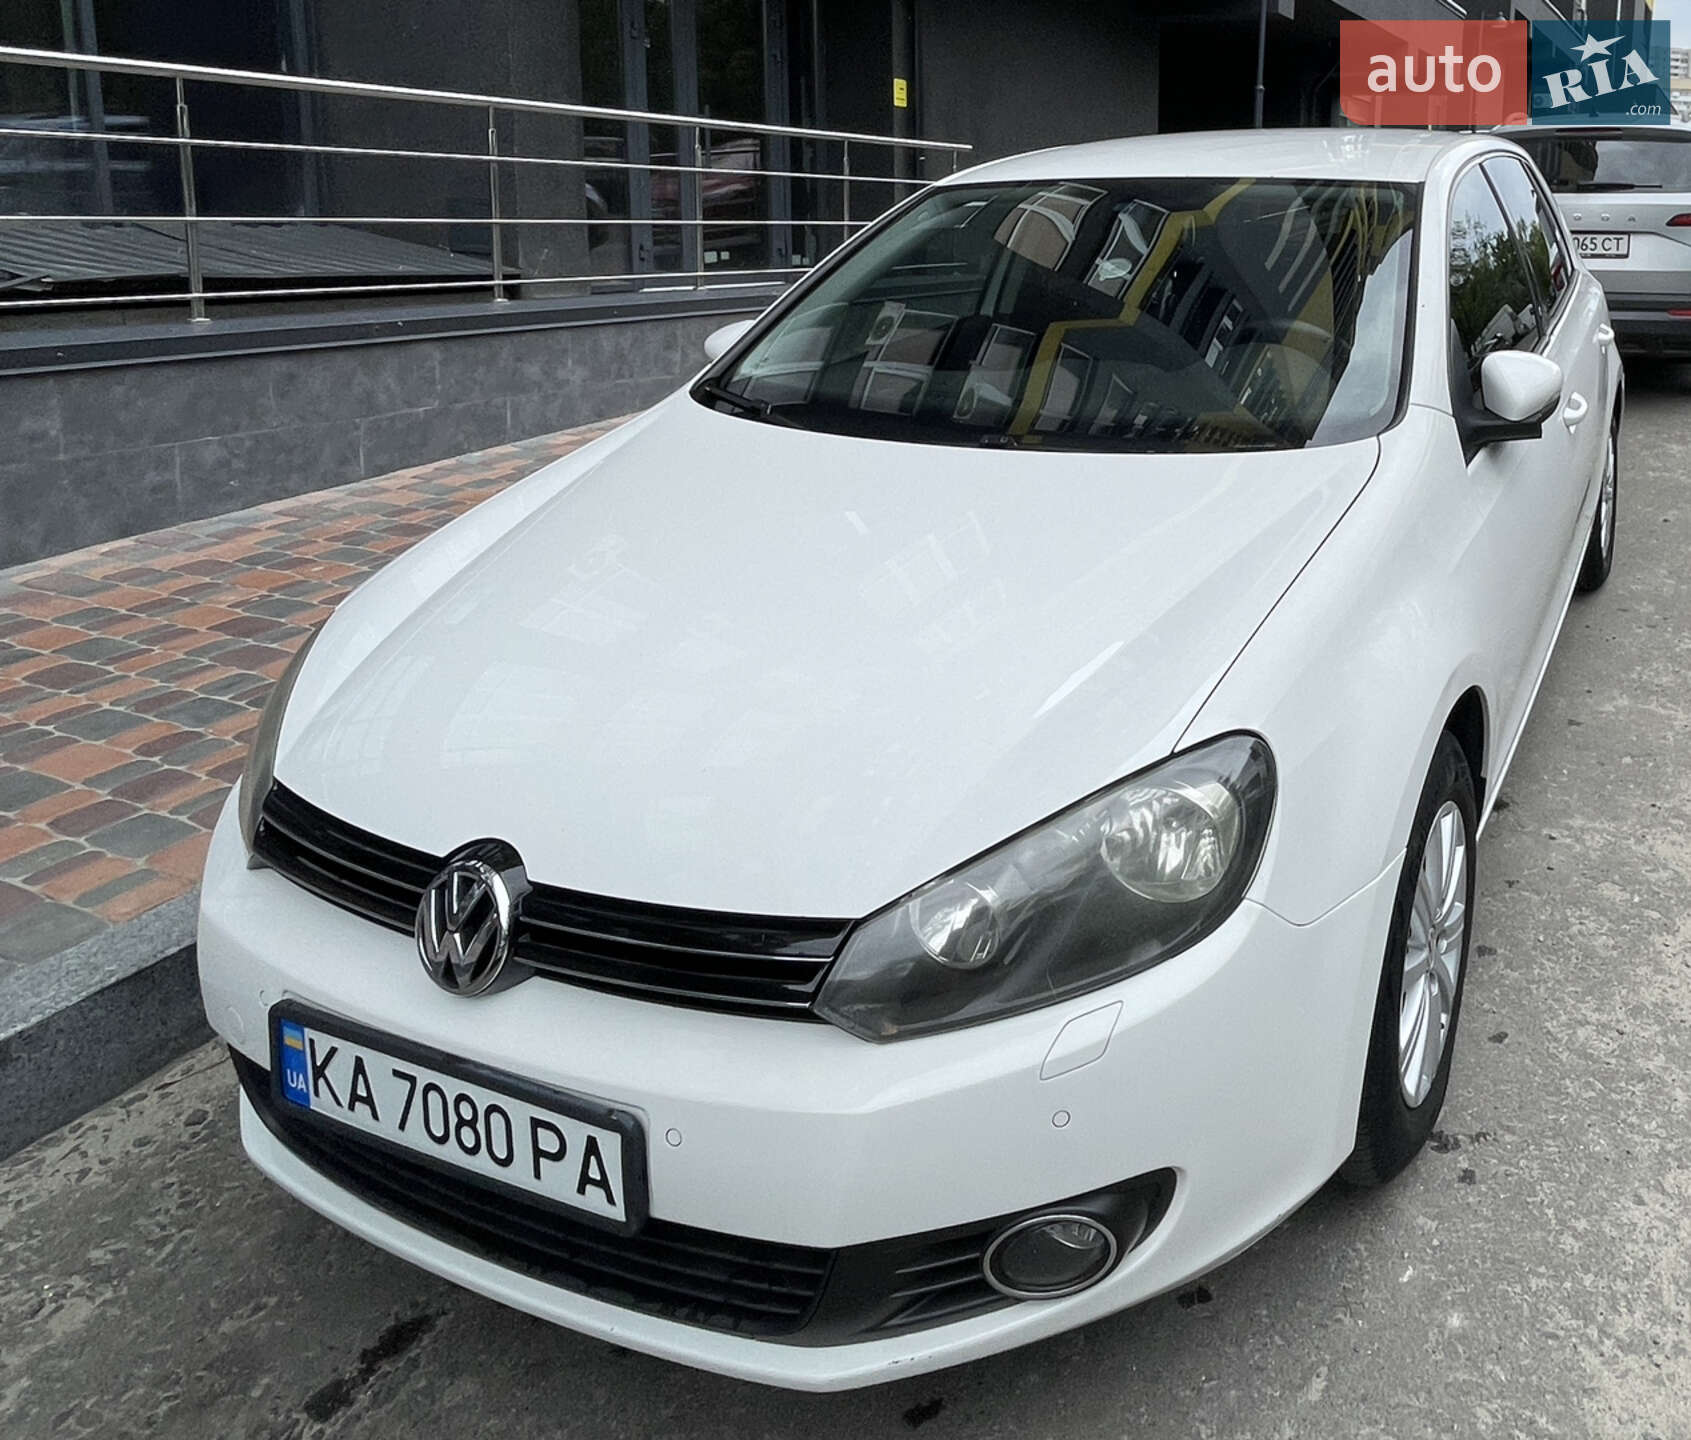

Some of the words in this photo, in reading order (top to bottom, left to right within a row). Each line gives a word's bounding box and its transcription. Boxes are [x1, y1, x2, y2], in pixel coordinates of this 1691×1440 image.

[1601, 236, 1623, 252] CT
[286, 1071, 307, 1092] UA
[308, 1037, 380, 1122] KA
[391, 1068, 514, 1168] 7080
[529, 1116, 616, 1208] PA
